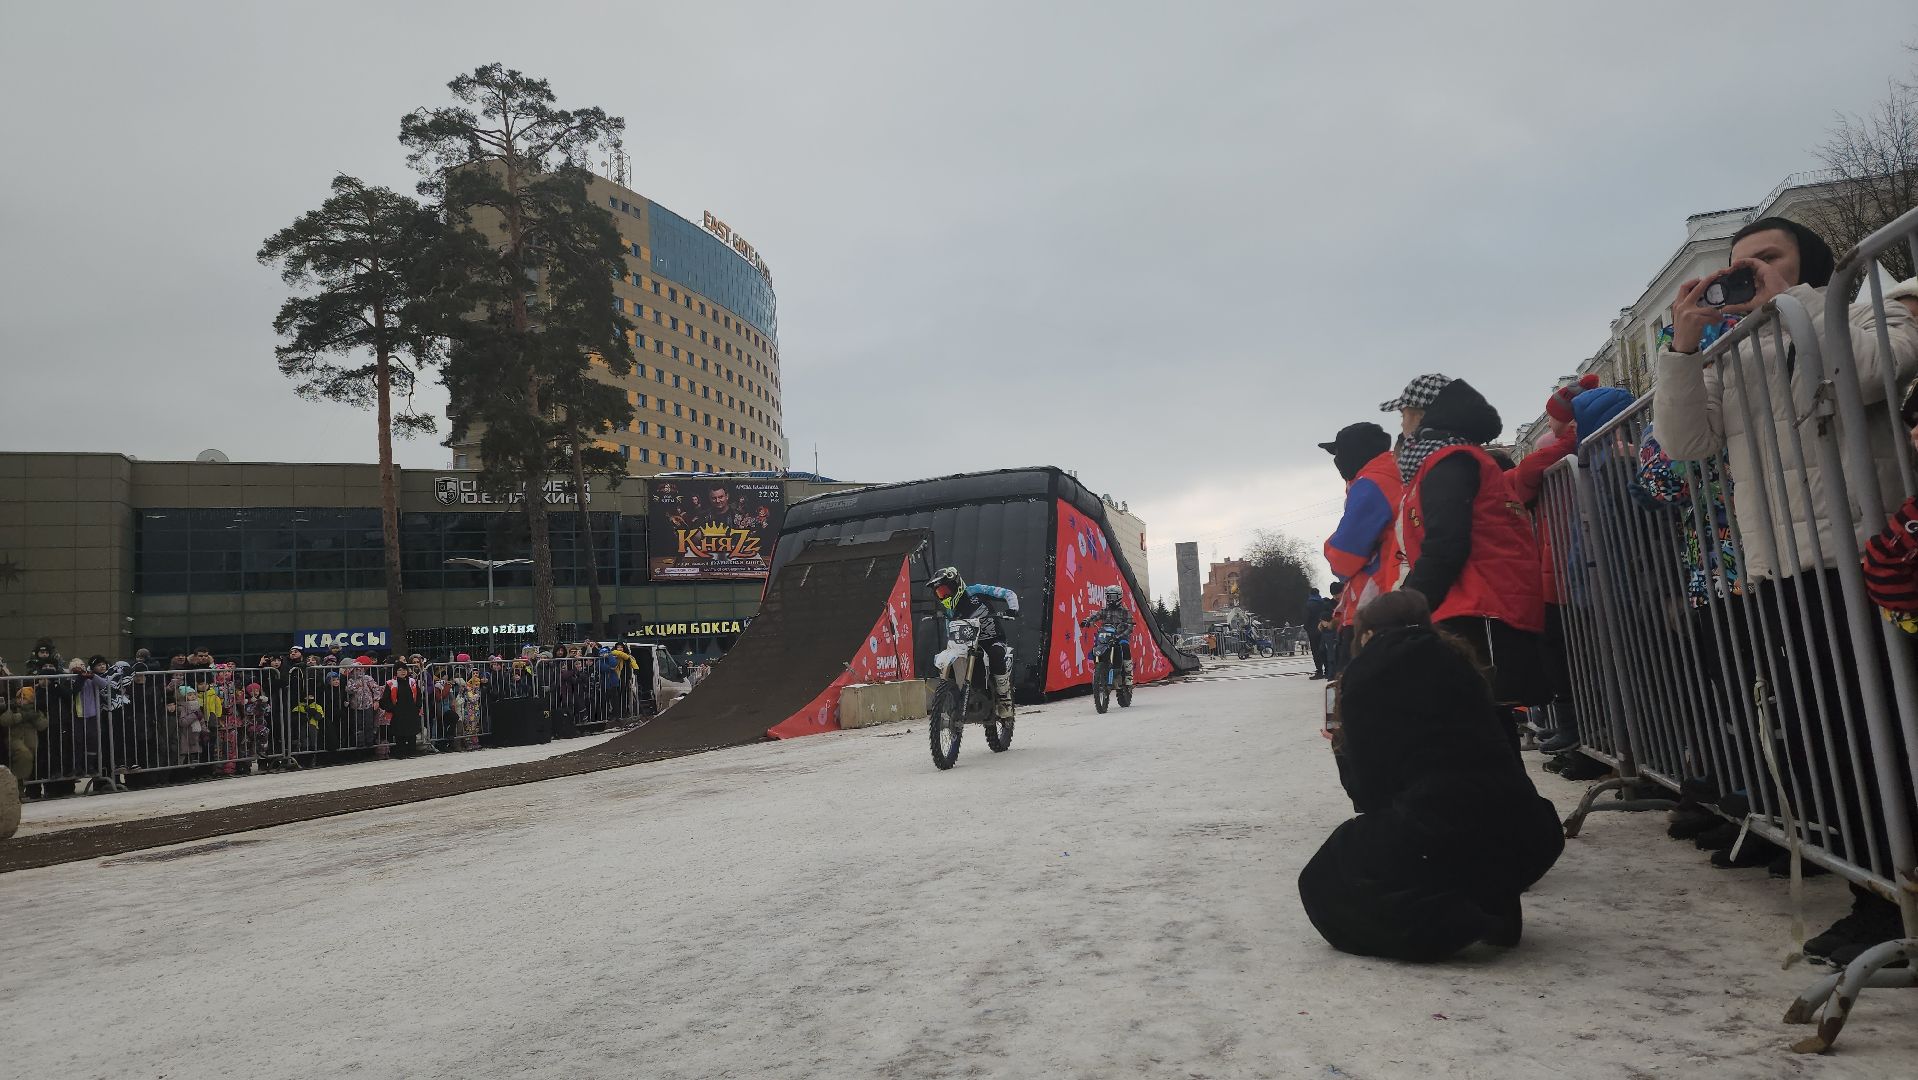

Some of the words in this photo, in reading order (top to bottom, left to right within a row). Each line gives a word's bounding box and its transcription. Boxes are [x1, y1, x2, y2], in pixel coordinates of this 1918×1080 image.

[703, 209, 731, 243] EAST
[732, 232, 756, 265] GATE
[758, 490, 779, 499] 22.02
[690, 621, 741, 634] БОКСА
[304, 630, 385, 648] КАССЫ
